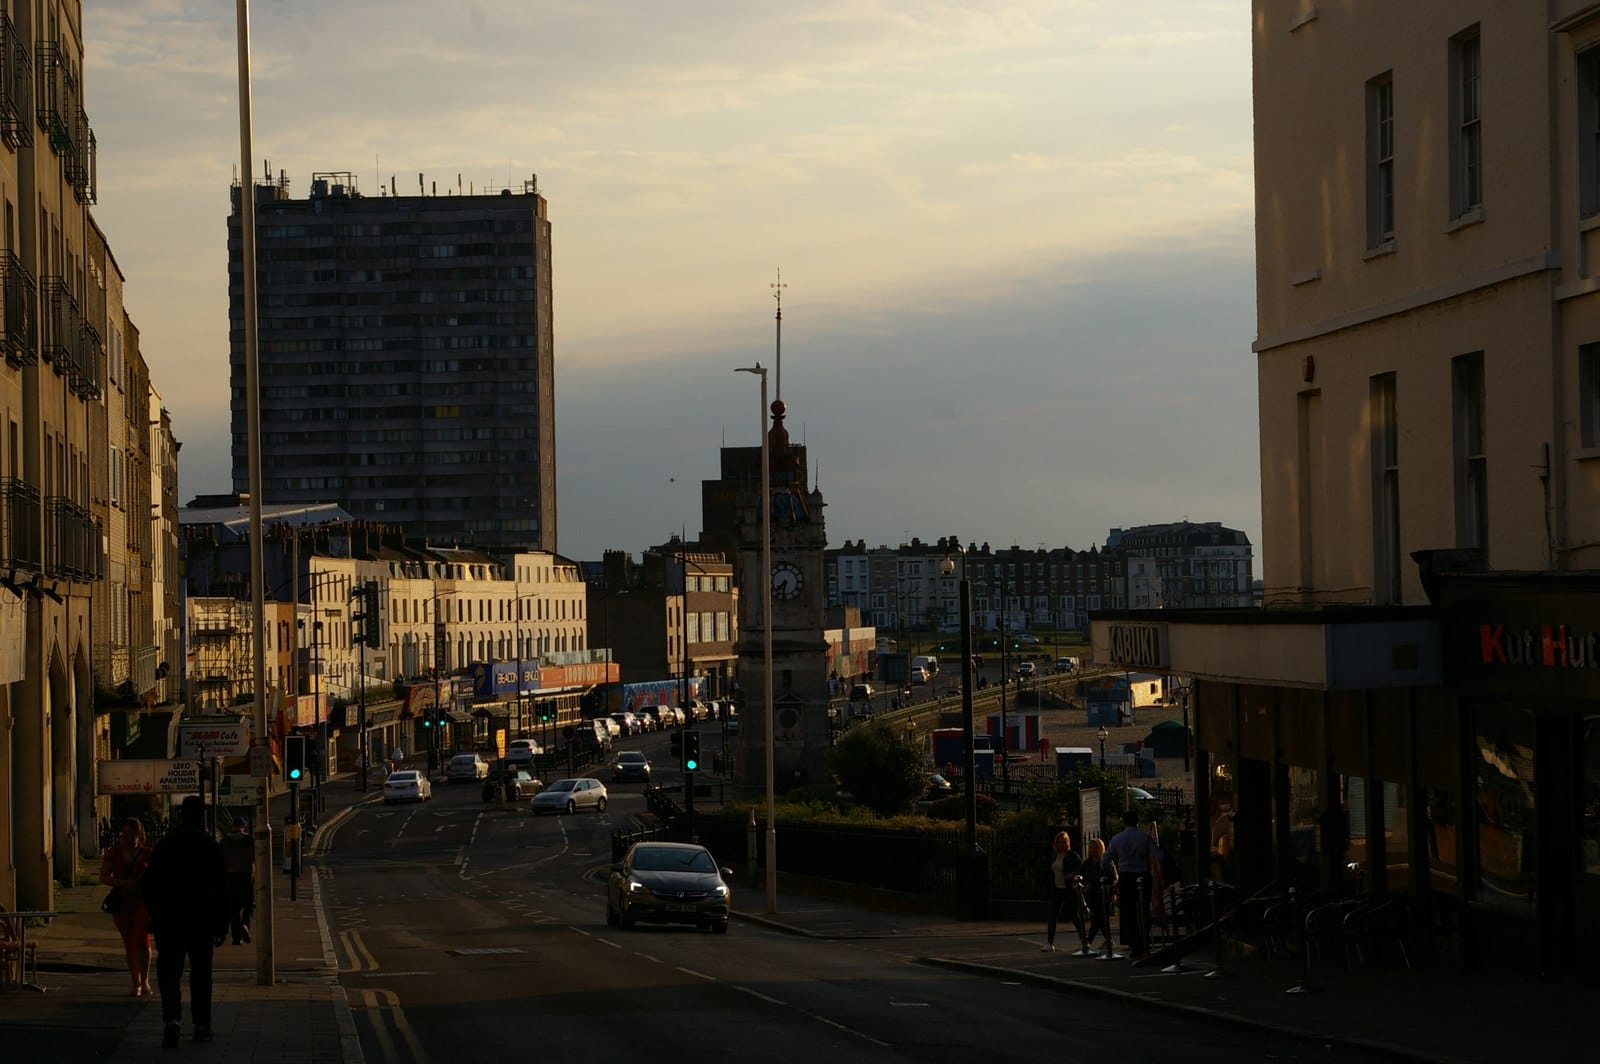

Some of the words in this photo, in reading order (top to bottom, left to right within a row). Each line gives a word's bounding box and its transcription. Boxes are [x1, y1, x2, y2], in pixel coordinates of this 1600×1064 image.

[1110, 626, 1157, 665] KABUKI
[1479, 623, 1534, 666] Kut
[1541, 623, 1599, 670] Hut
[168, 769, 196, 777] HOLIDAY
